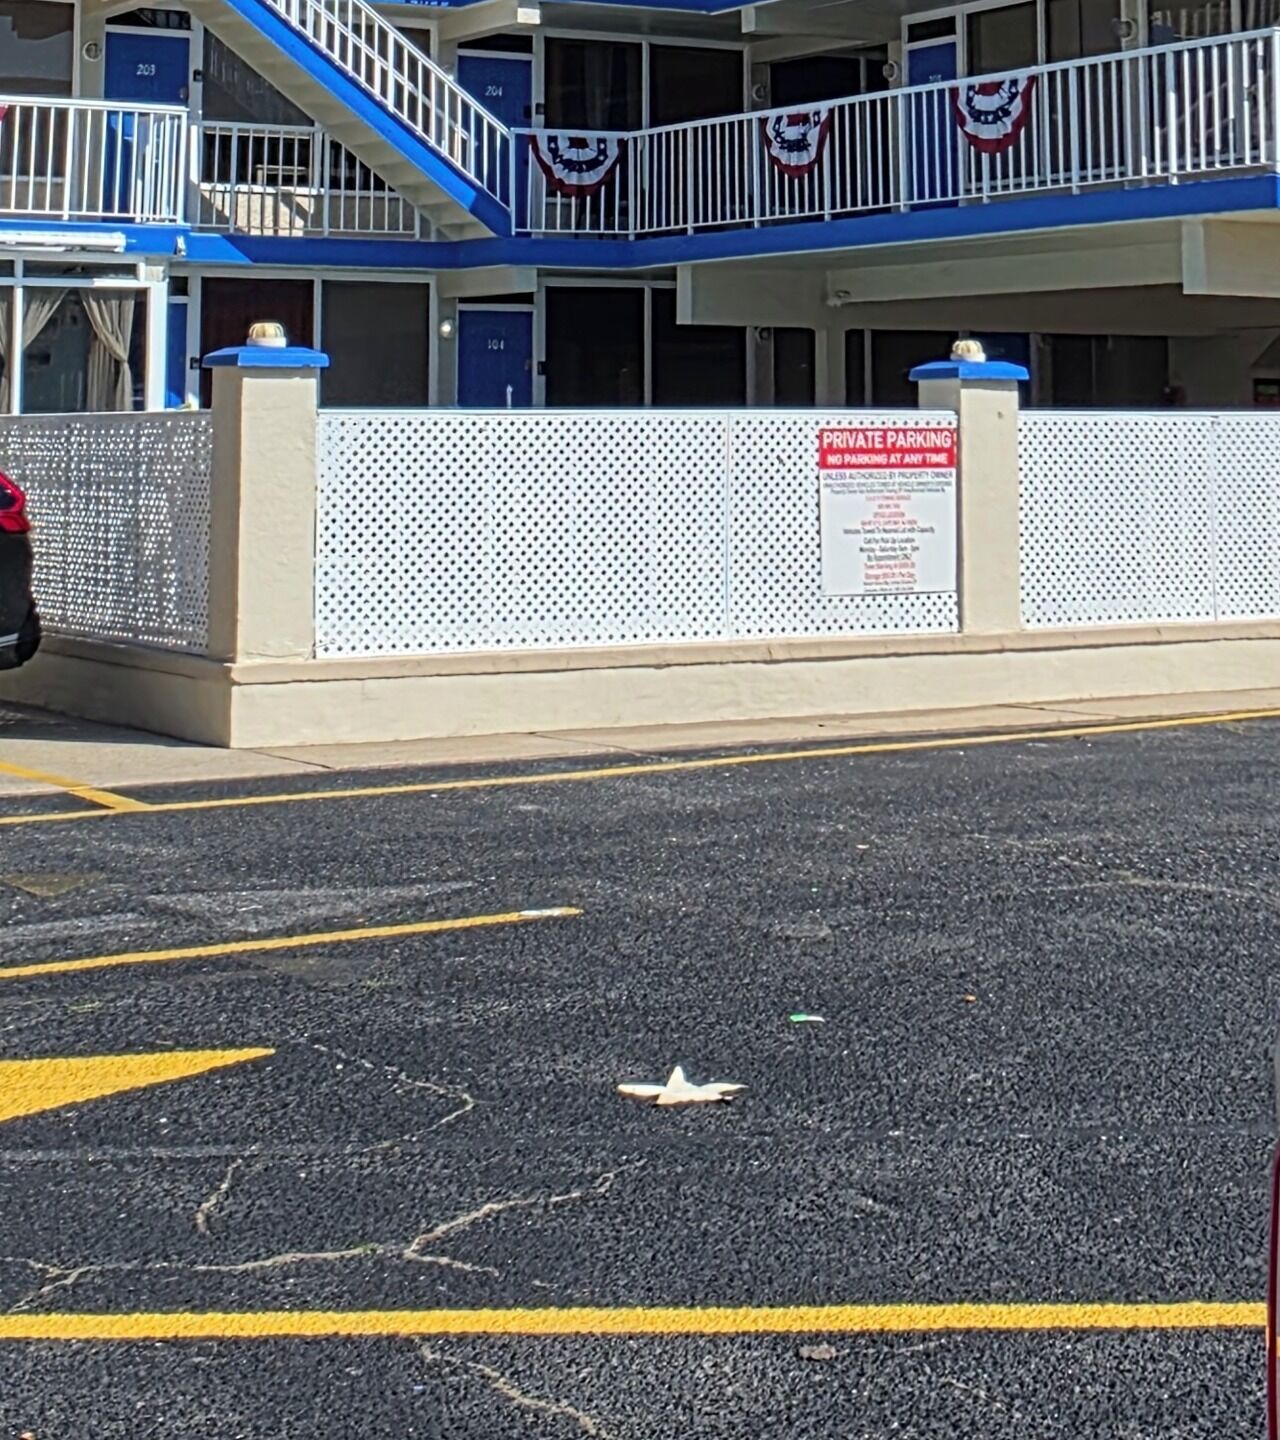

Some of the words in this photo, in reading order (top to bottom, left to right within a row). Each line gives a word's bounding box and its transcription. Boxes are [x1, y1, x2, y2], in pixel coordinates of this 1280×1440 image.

[135, 63, 156, 76] 203
[823, 431, 884, 448] PRIVATE
[886, 431, 952, 448] PARKING
[827, 455, 842, 465] NO
[844, 454, 888, 465] PARKING
[889, 453, 901, 464] AT
[903, 453, 925, 464] ANY
[926, 453, 948, 464] TIME
[823, 472, 847, 480] UNLESS
[848, 472, 888, 480] AUTHORIZED
[897, 471, 929, 479] PROPERTY
[930, 470, 953, 478] OWNER
